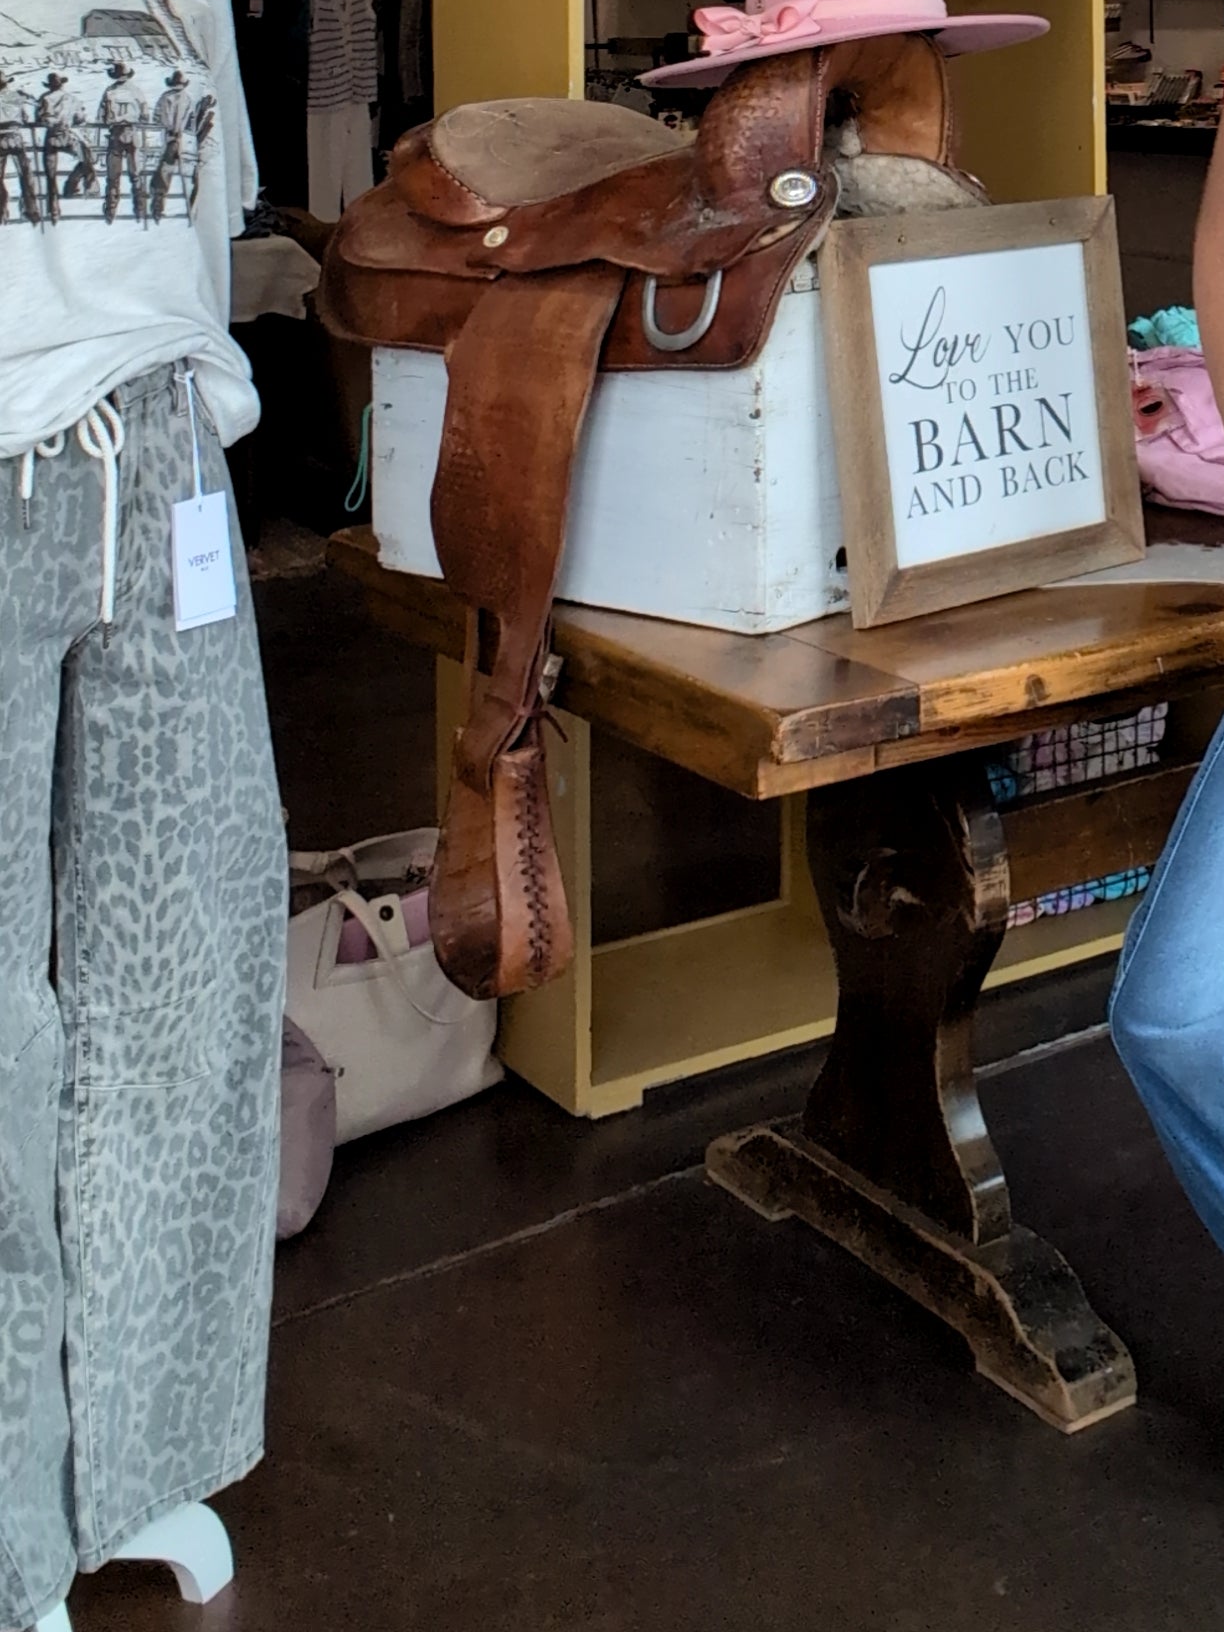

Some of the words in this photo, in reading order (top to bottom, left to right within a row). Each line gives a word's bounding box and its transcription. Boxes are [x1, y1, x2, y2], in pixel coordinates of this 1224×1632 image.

[888, 285, 992, 390] Love
[1003, 315, 1076, 355] YOU
[943, 378, 977, 405] TO
[988, 368, 1039, 395] THE
[908, 392, 1075, 475] BARN
[906, 474, 983, 520] AND
[1001, 451, 1089, 499] BACK
[189, 550, 219, 566] VERVET
